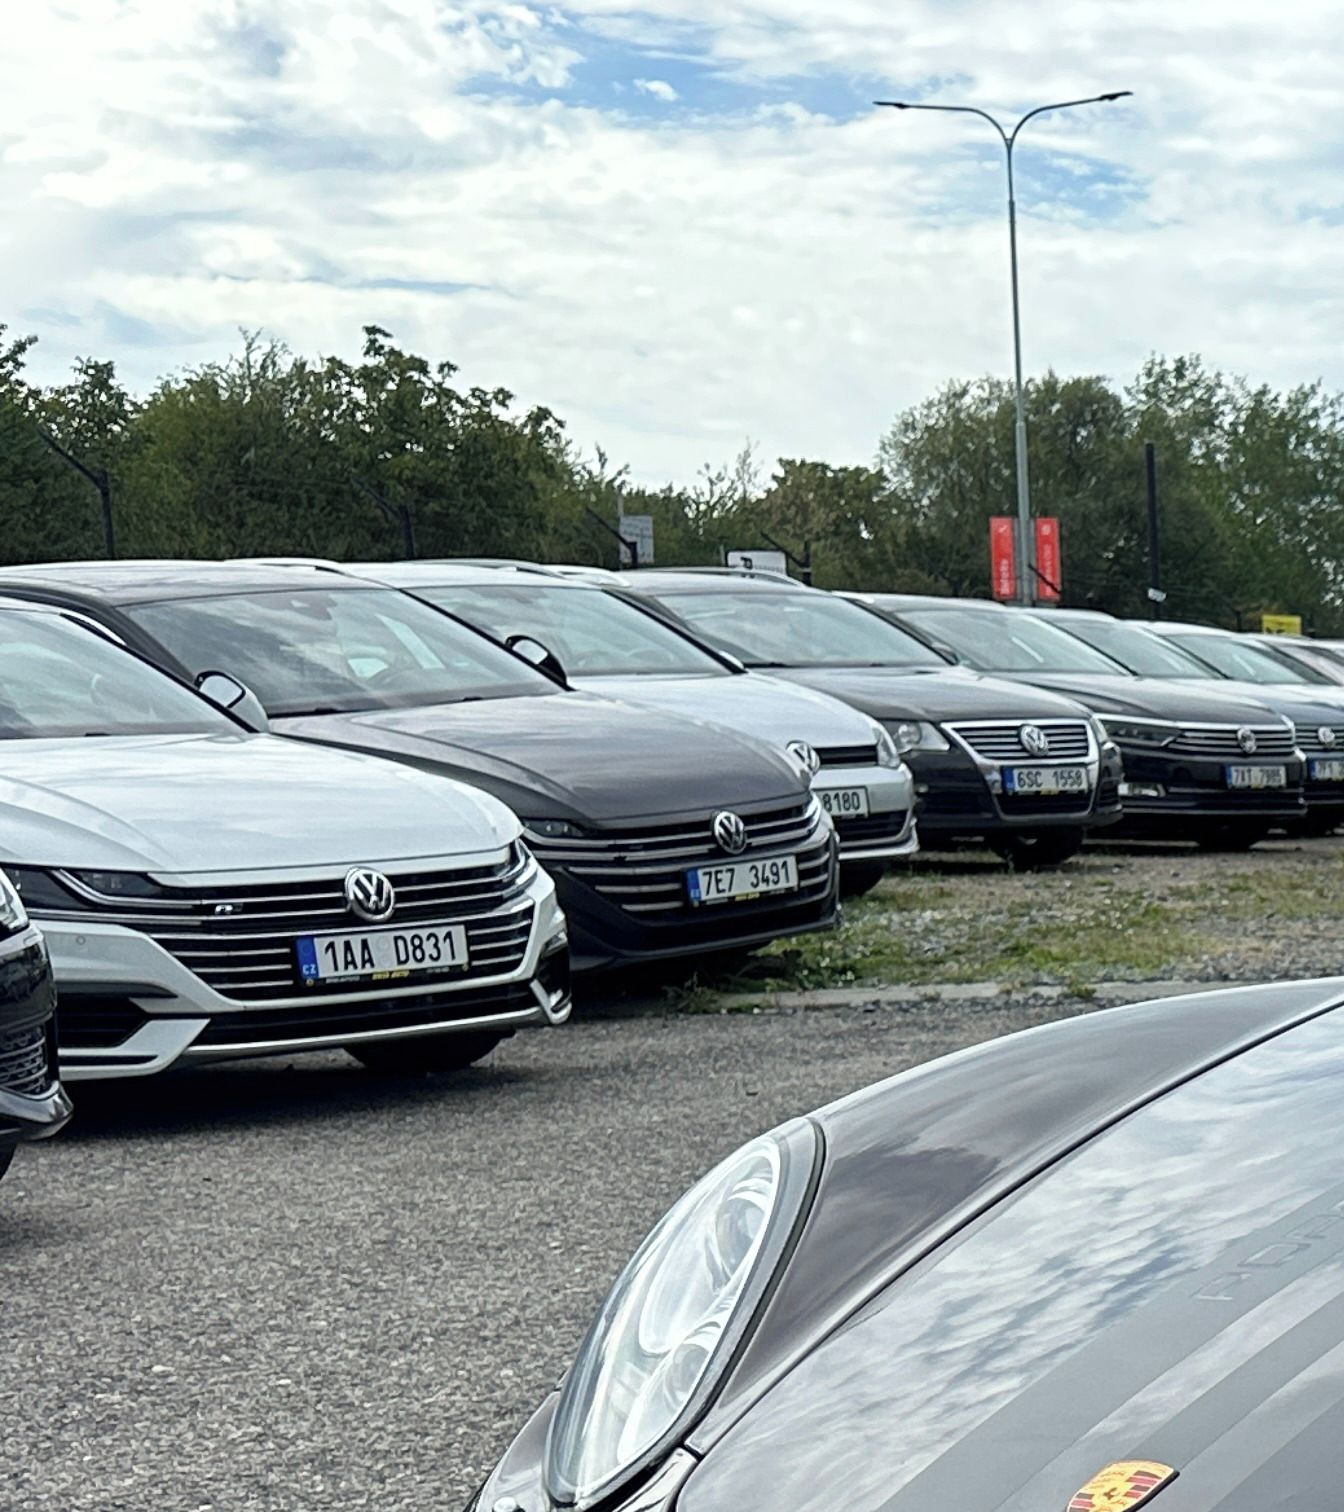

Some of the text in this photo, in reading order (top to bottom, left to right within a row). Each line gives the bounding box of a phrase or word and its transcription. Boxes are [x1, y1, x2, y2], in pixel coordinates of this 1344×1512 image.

[822, 790, 862, 813] 8180
[702, 860, 790, 896] 7E7 3491
[324, 931, 457, 972] 1AA D831
